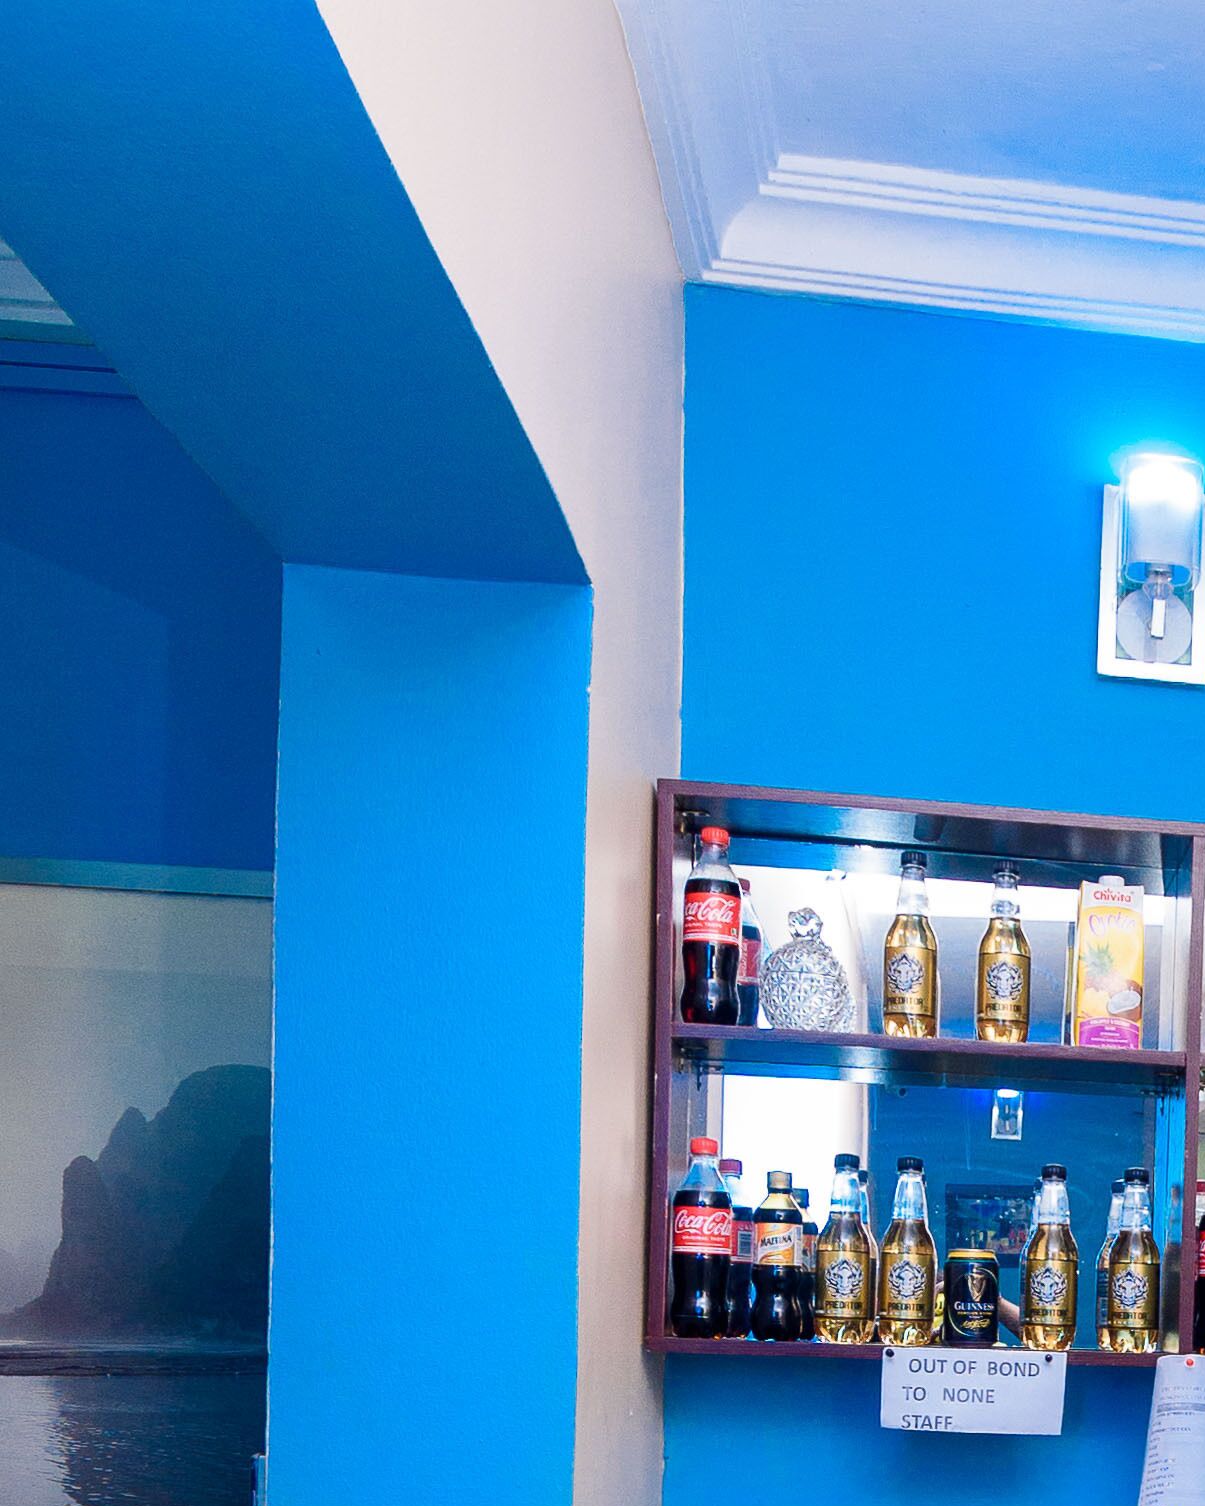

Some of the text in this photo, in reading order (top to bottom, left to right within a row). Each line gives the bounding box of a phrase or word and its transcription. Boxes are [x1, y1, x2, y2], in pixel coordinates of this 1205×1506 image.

[1093, 889, 1132, 903] Chivita
[953, 1300, 995, 1311] GUINNESS
[908, 1358, 1040, 1377] OUT OF BOND
[902, 1385, 996, 1404] TO NONE
[900, 1414, 953, 1430] STAFF
